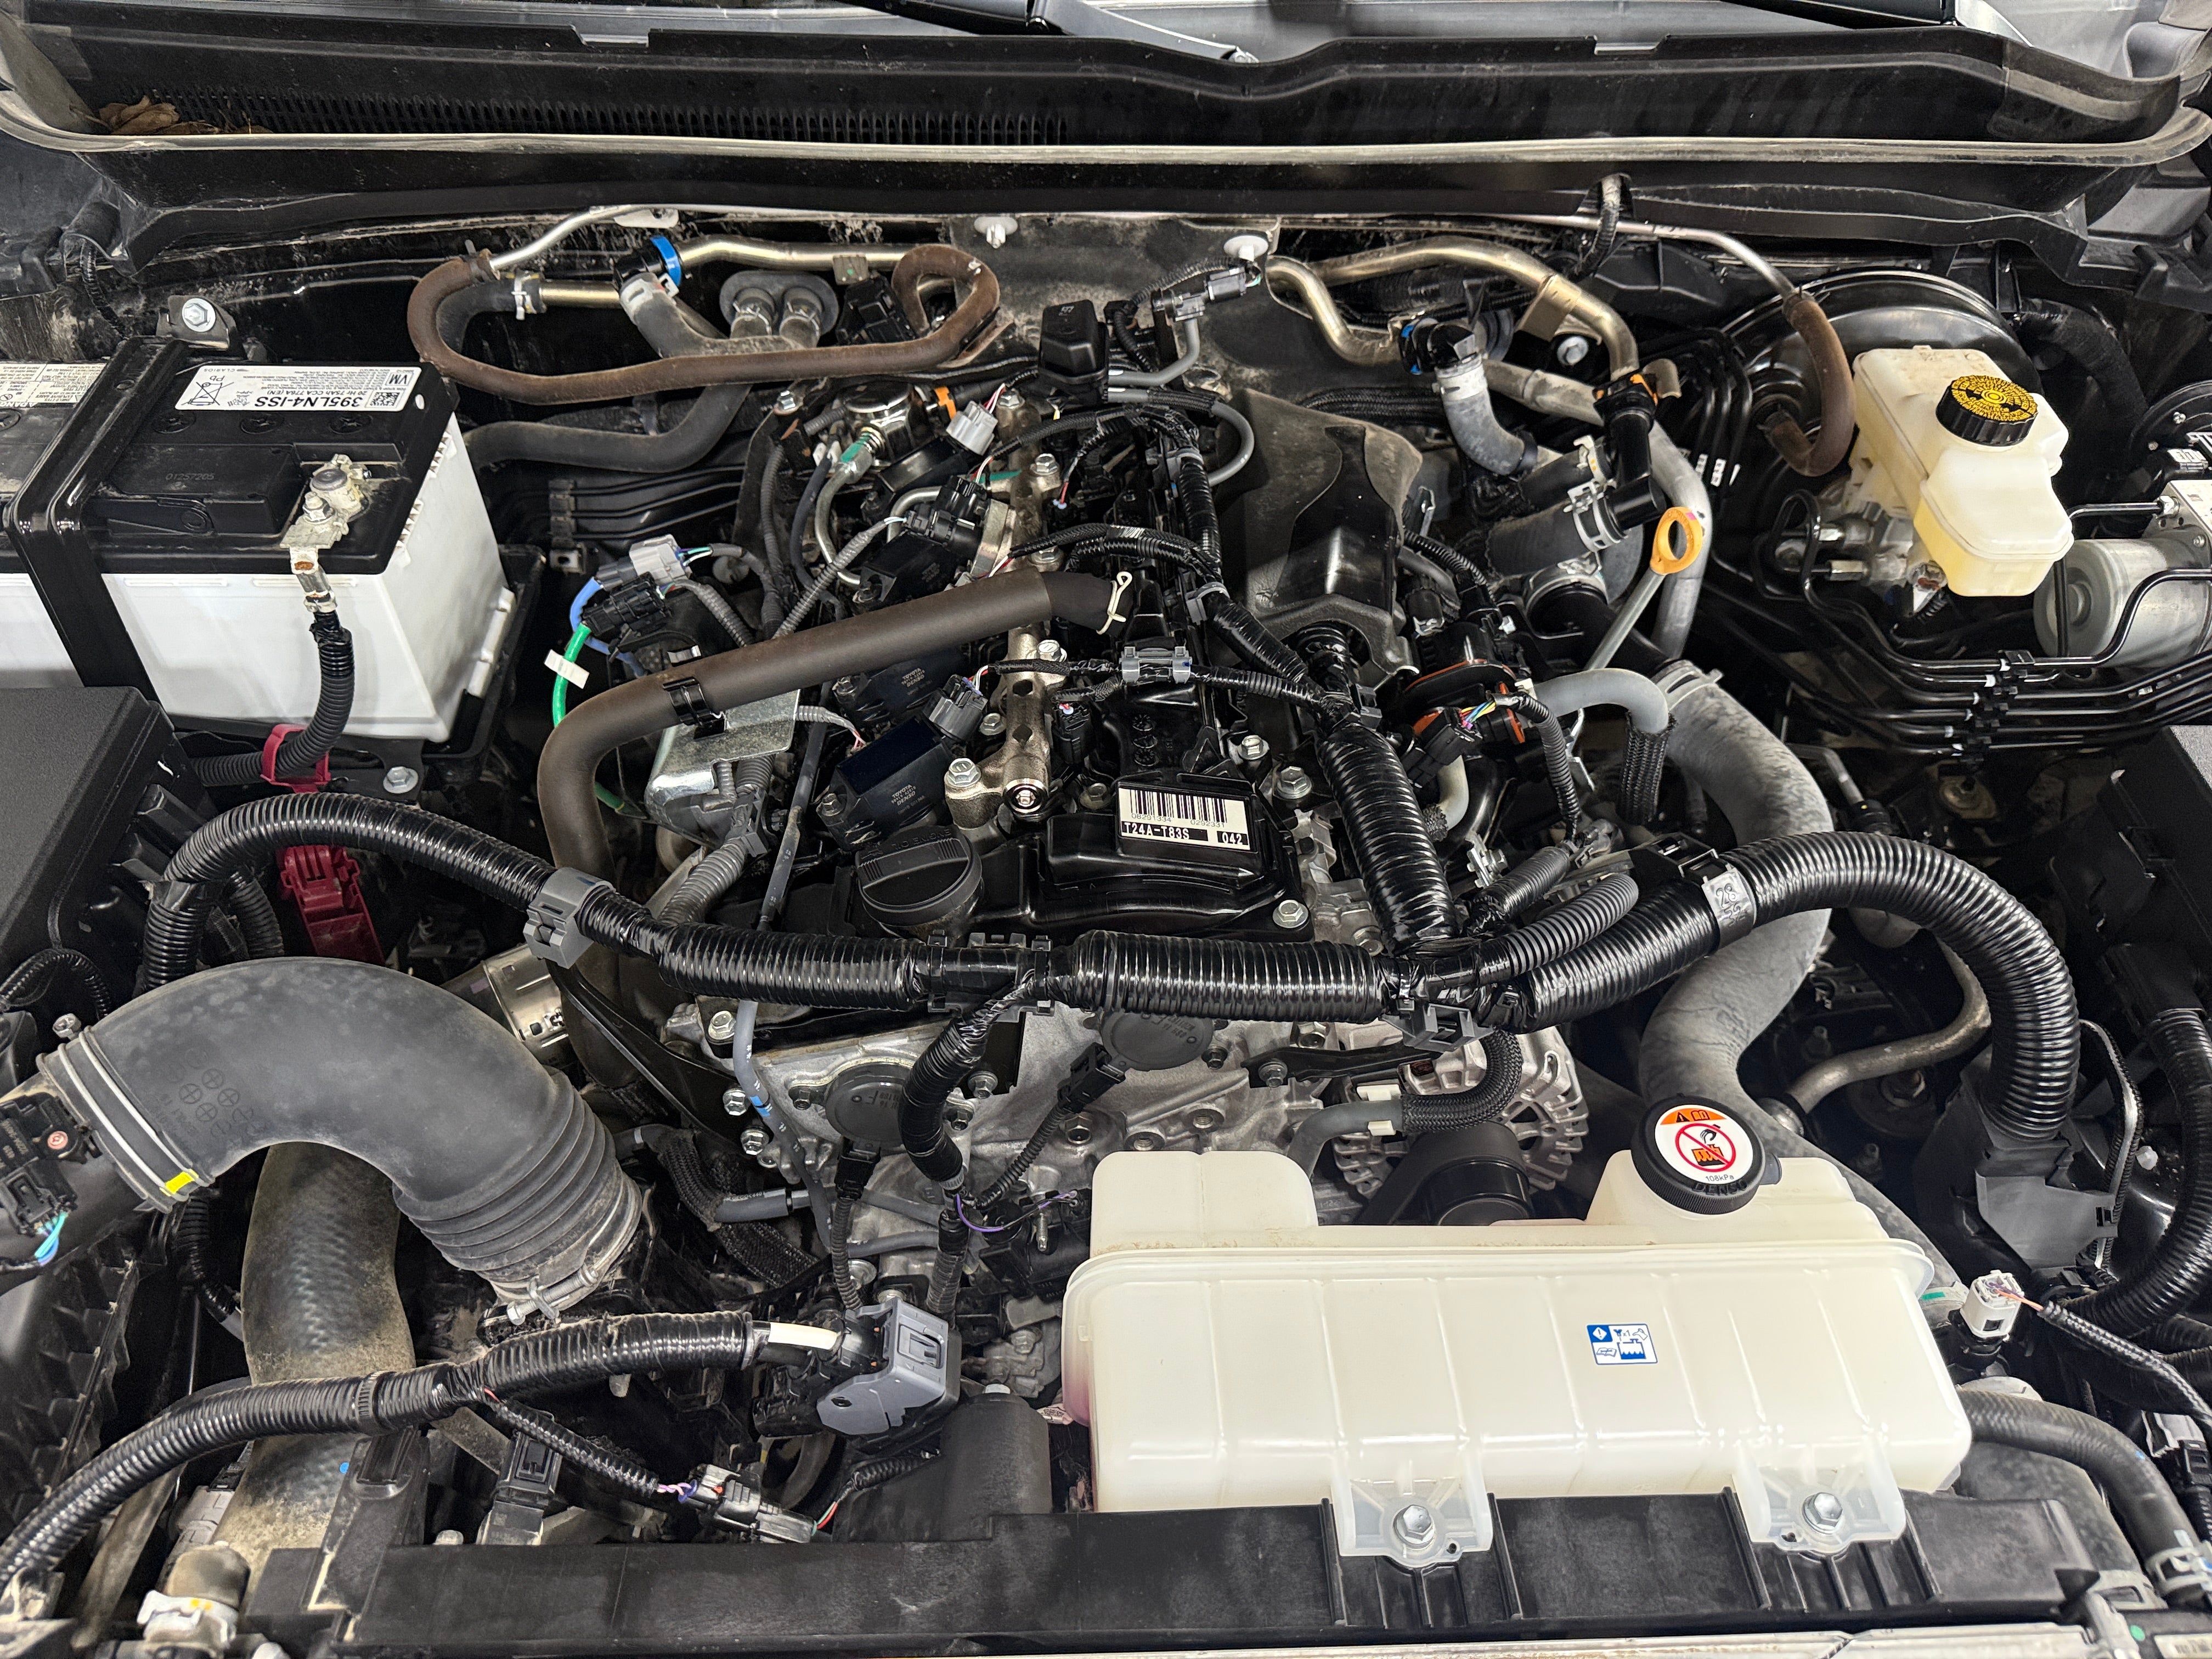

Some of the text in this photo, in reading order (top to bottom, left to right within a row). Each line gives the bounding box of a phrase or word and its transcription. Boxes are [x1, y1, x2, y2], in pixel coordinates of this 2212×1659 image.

[389, 374, 408, 384] VM
[255, 396, 363, 407] 395LN4-ISS
[902, 668, 922, 680] TOYOTA
[891, 784, 912, 798] TOYOTA
[897, 791, 916, 806] DENSO
[1131, 813, 1225, 828] 08291334 0292331
[891, 829, 952, 850] ENGINE OIL
[1125, 822, 1243, 845] T24A-T83S 042
[1716, 883, 1737, 909] 28
[1705, 1173, 1735, 1182] 108kPa
[1691, 1179, 1747, 1196] DENSO
